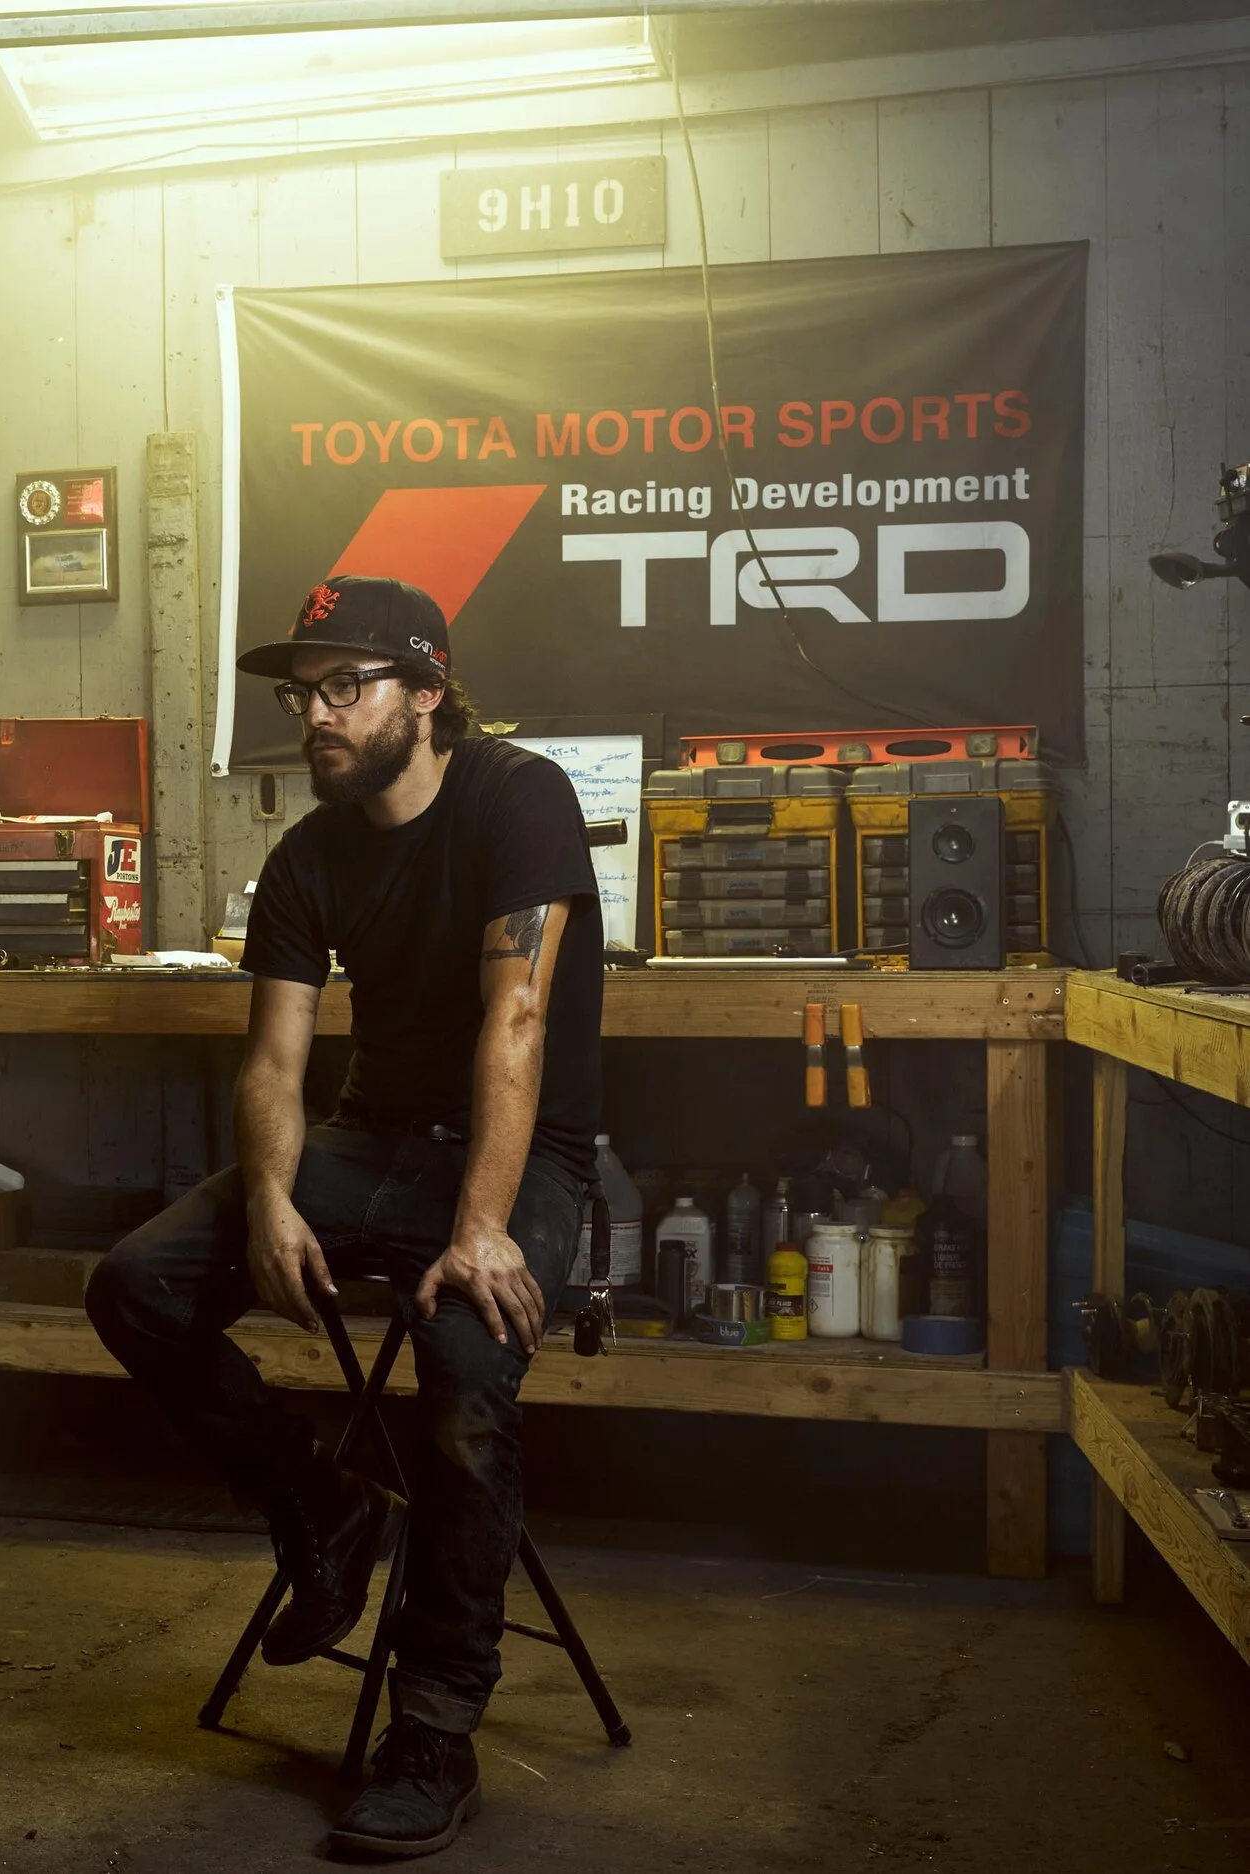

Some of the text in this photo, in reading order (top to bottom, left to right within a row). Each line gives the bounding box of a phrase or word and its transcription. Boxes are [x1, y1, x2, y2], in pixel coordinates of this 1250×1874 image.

[291, 389, 1031, 467] TOYOTA MOTOR SPORTS
[561, 467, 1030, 519] Racing Development
[561, 520, 1031, 628] TRD
[107, 839, 138, 877] JE
[116, 872, 139, 882] PISTONS
[718, 1324, 740, 1337] blue
